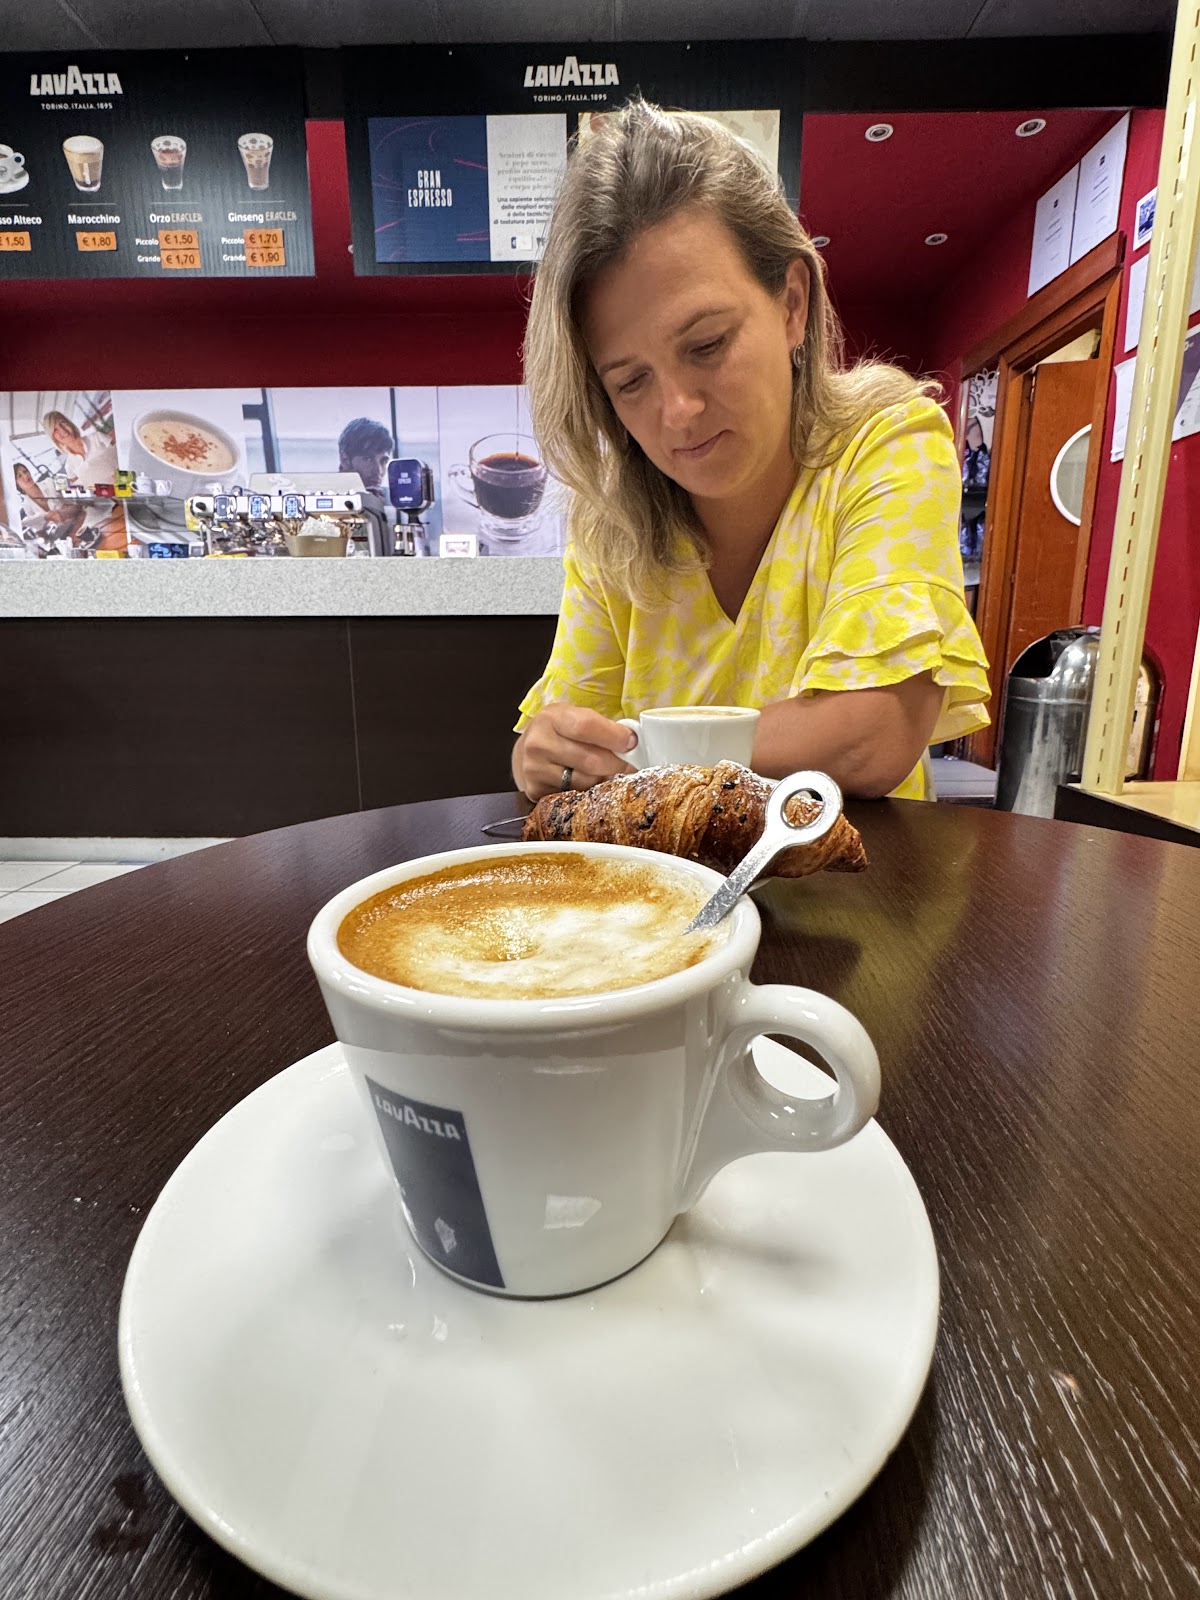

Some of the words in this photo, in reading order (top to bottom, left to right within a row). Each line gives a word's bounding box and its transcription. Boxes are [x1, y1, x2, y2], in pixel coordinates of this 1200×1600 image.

[523, 56, 620, 88] LAVAZZA
[30, 65, 123, 95] LAVAZZA
[417, 170, 441, 189] GRAN
[407, 188, 453, 208] ESPRESSO
[13, 215, 42, 225] Alteco
[68, 214, 120, 224] Marocchino
[149, 213, 171, 223] Orzo
[228, 212, 264, 223] Ginseng
[82, 237, 90, 246] €
[135, 238, 159, 246] Piccolo
[164, 235, 172, 244] €
[221, 237, 245, 245] Piccolo
[249, 233, 256, 244] €
[137, 255, 161, 263] Grande
[166, 254, 173, 264] €
[222, 254, 247, 262] Grande
[250, 252, 258, 263] €
[374, 1093, 461, 1140] LAVAZZA
